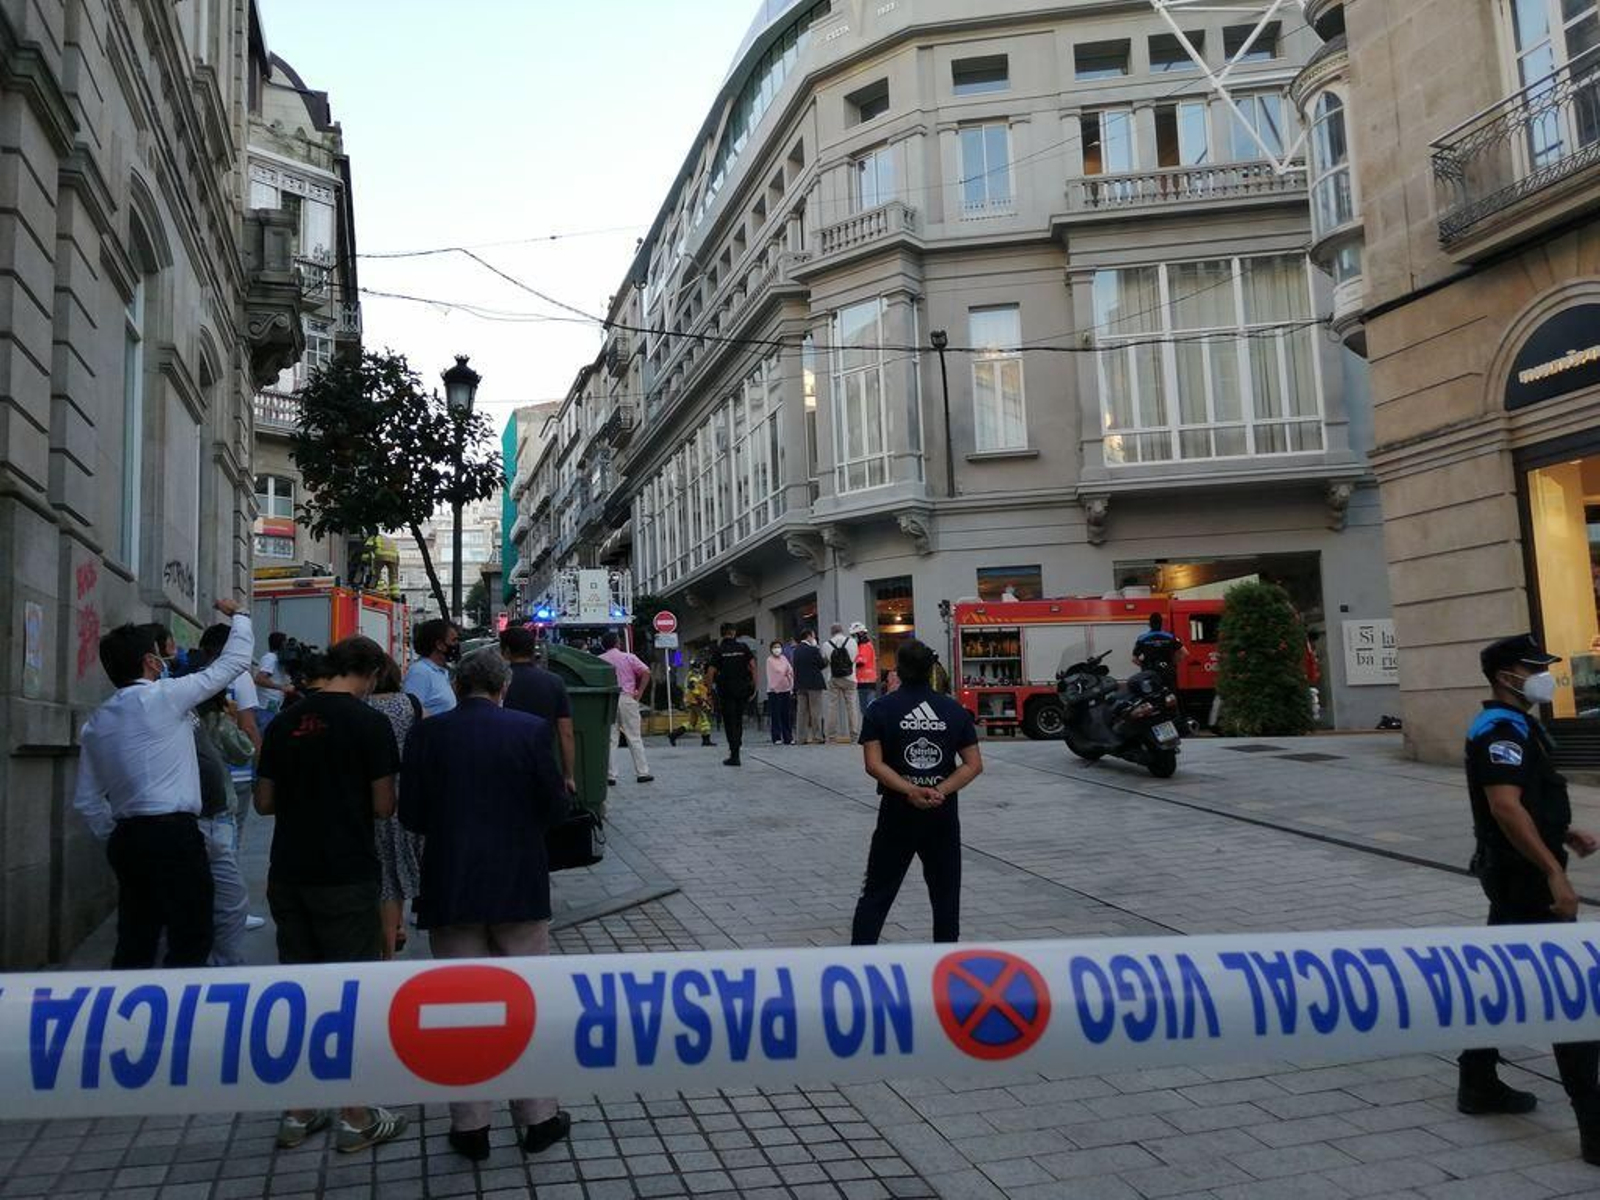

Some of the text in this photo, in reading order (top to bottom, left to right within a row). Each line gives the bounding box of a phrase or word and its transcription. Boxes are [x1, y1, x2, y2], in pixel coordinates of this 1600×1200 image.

[1356, 652, 1374, 666] ba
[1359, 629, 1395, 644] Si la
[899, 719, 947, 731] adidas
[904, 775, 944, 786] BANC
[571, 963, 914, 1069] NO PASAR
[1069, 953, 1221, 1044] VIGO
[1218, 947, 1410, 1036] LOCAL
[29, 980, 360, 1091] POLICIA
